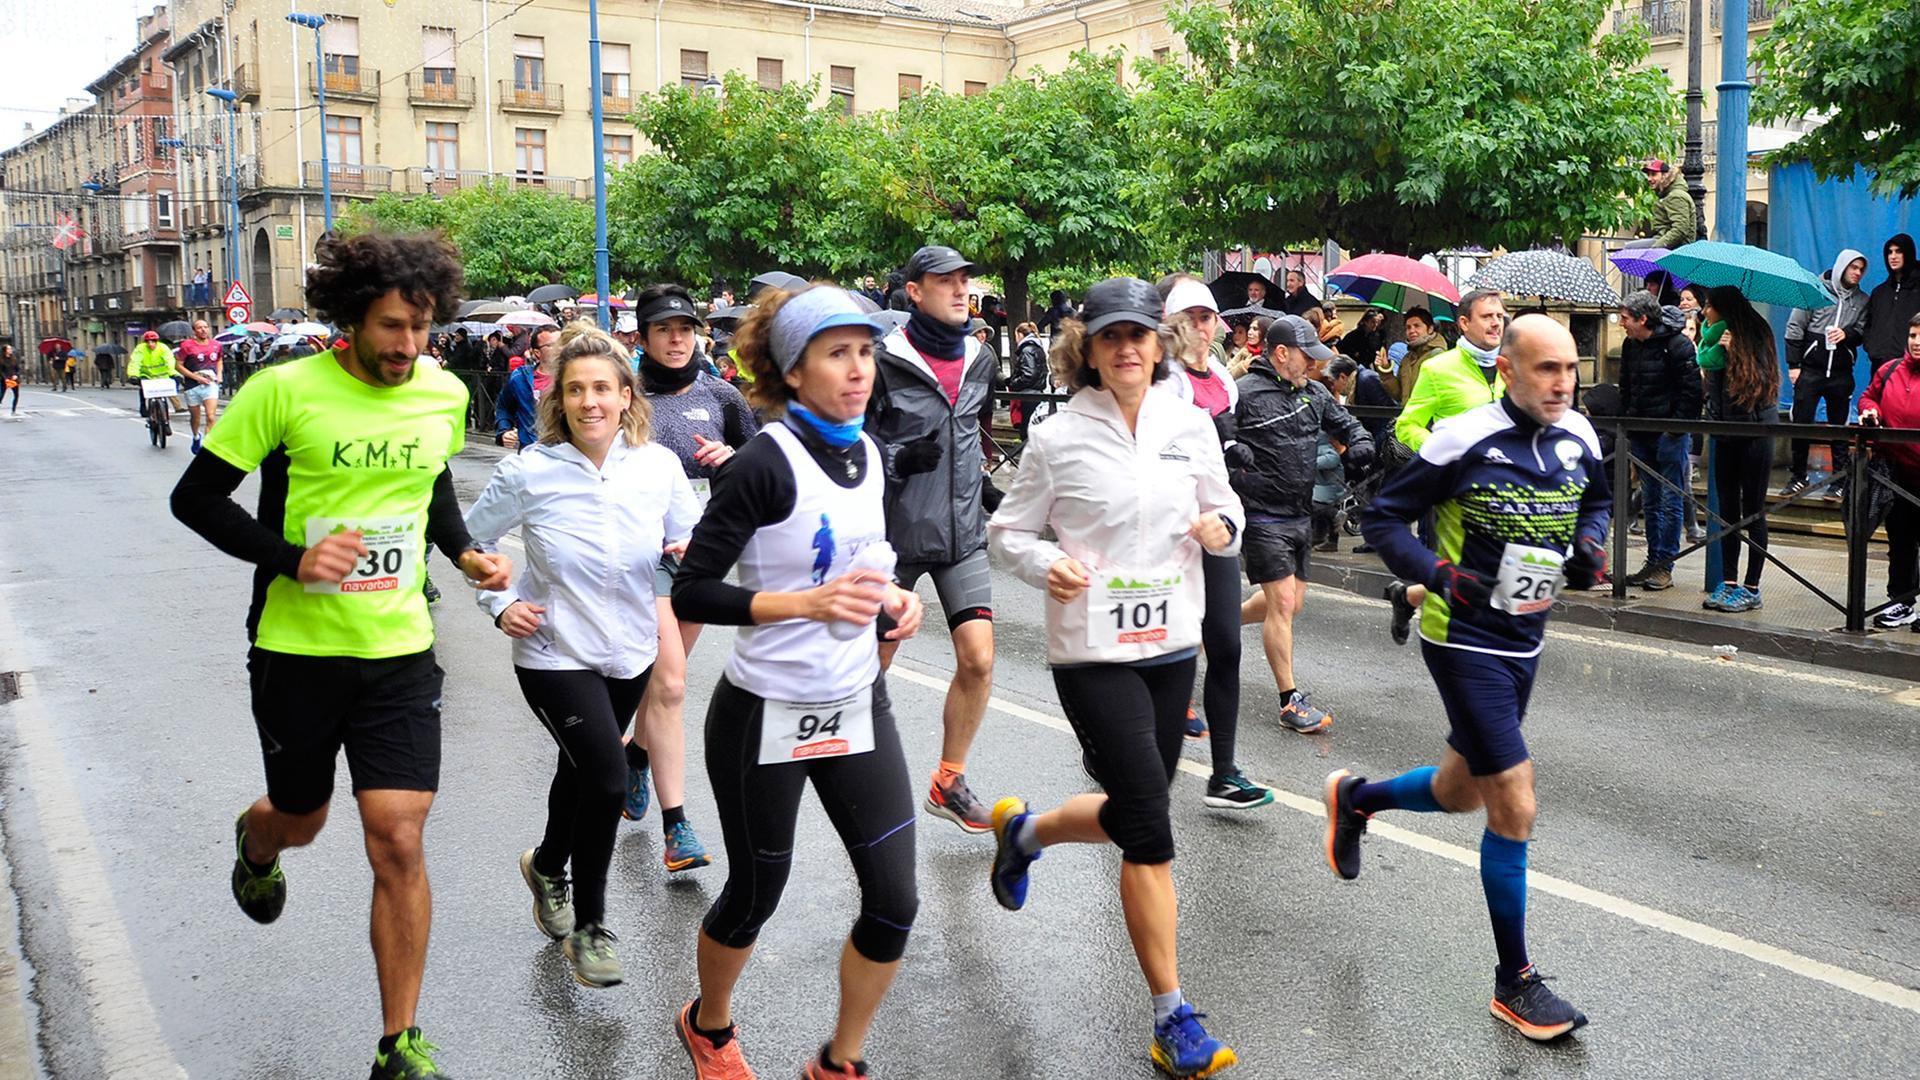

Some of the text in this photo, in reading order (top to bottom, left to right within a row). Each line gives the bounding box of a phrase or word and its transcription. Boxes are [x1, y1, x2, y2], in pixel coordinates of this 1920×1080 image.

[343, 578, 398, 592] navarban
[1109, 600, 1168, 629] 101
[796, 710, 844, 741] 94
